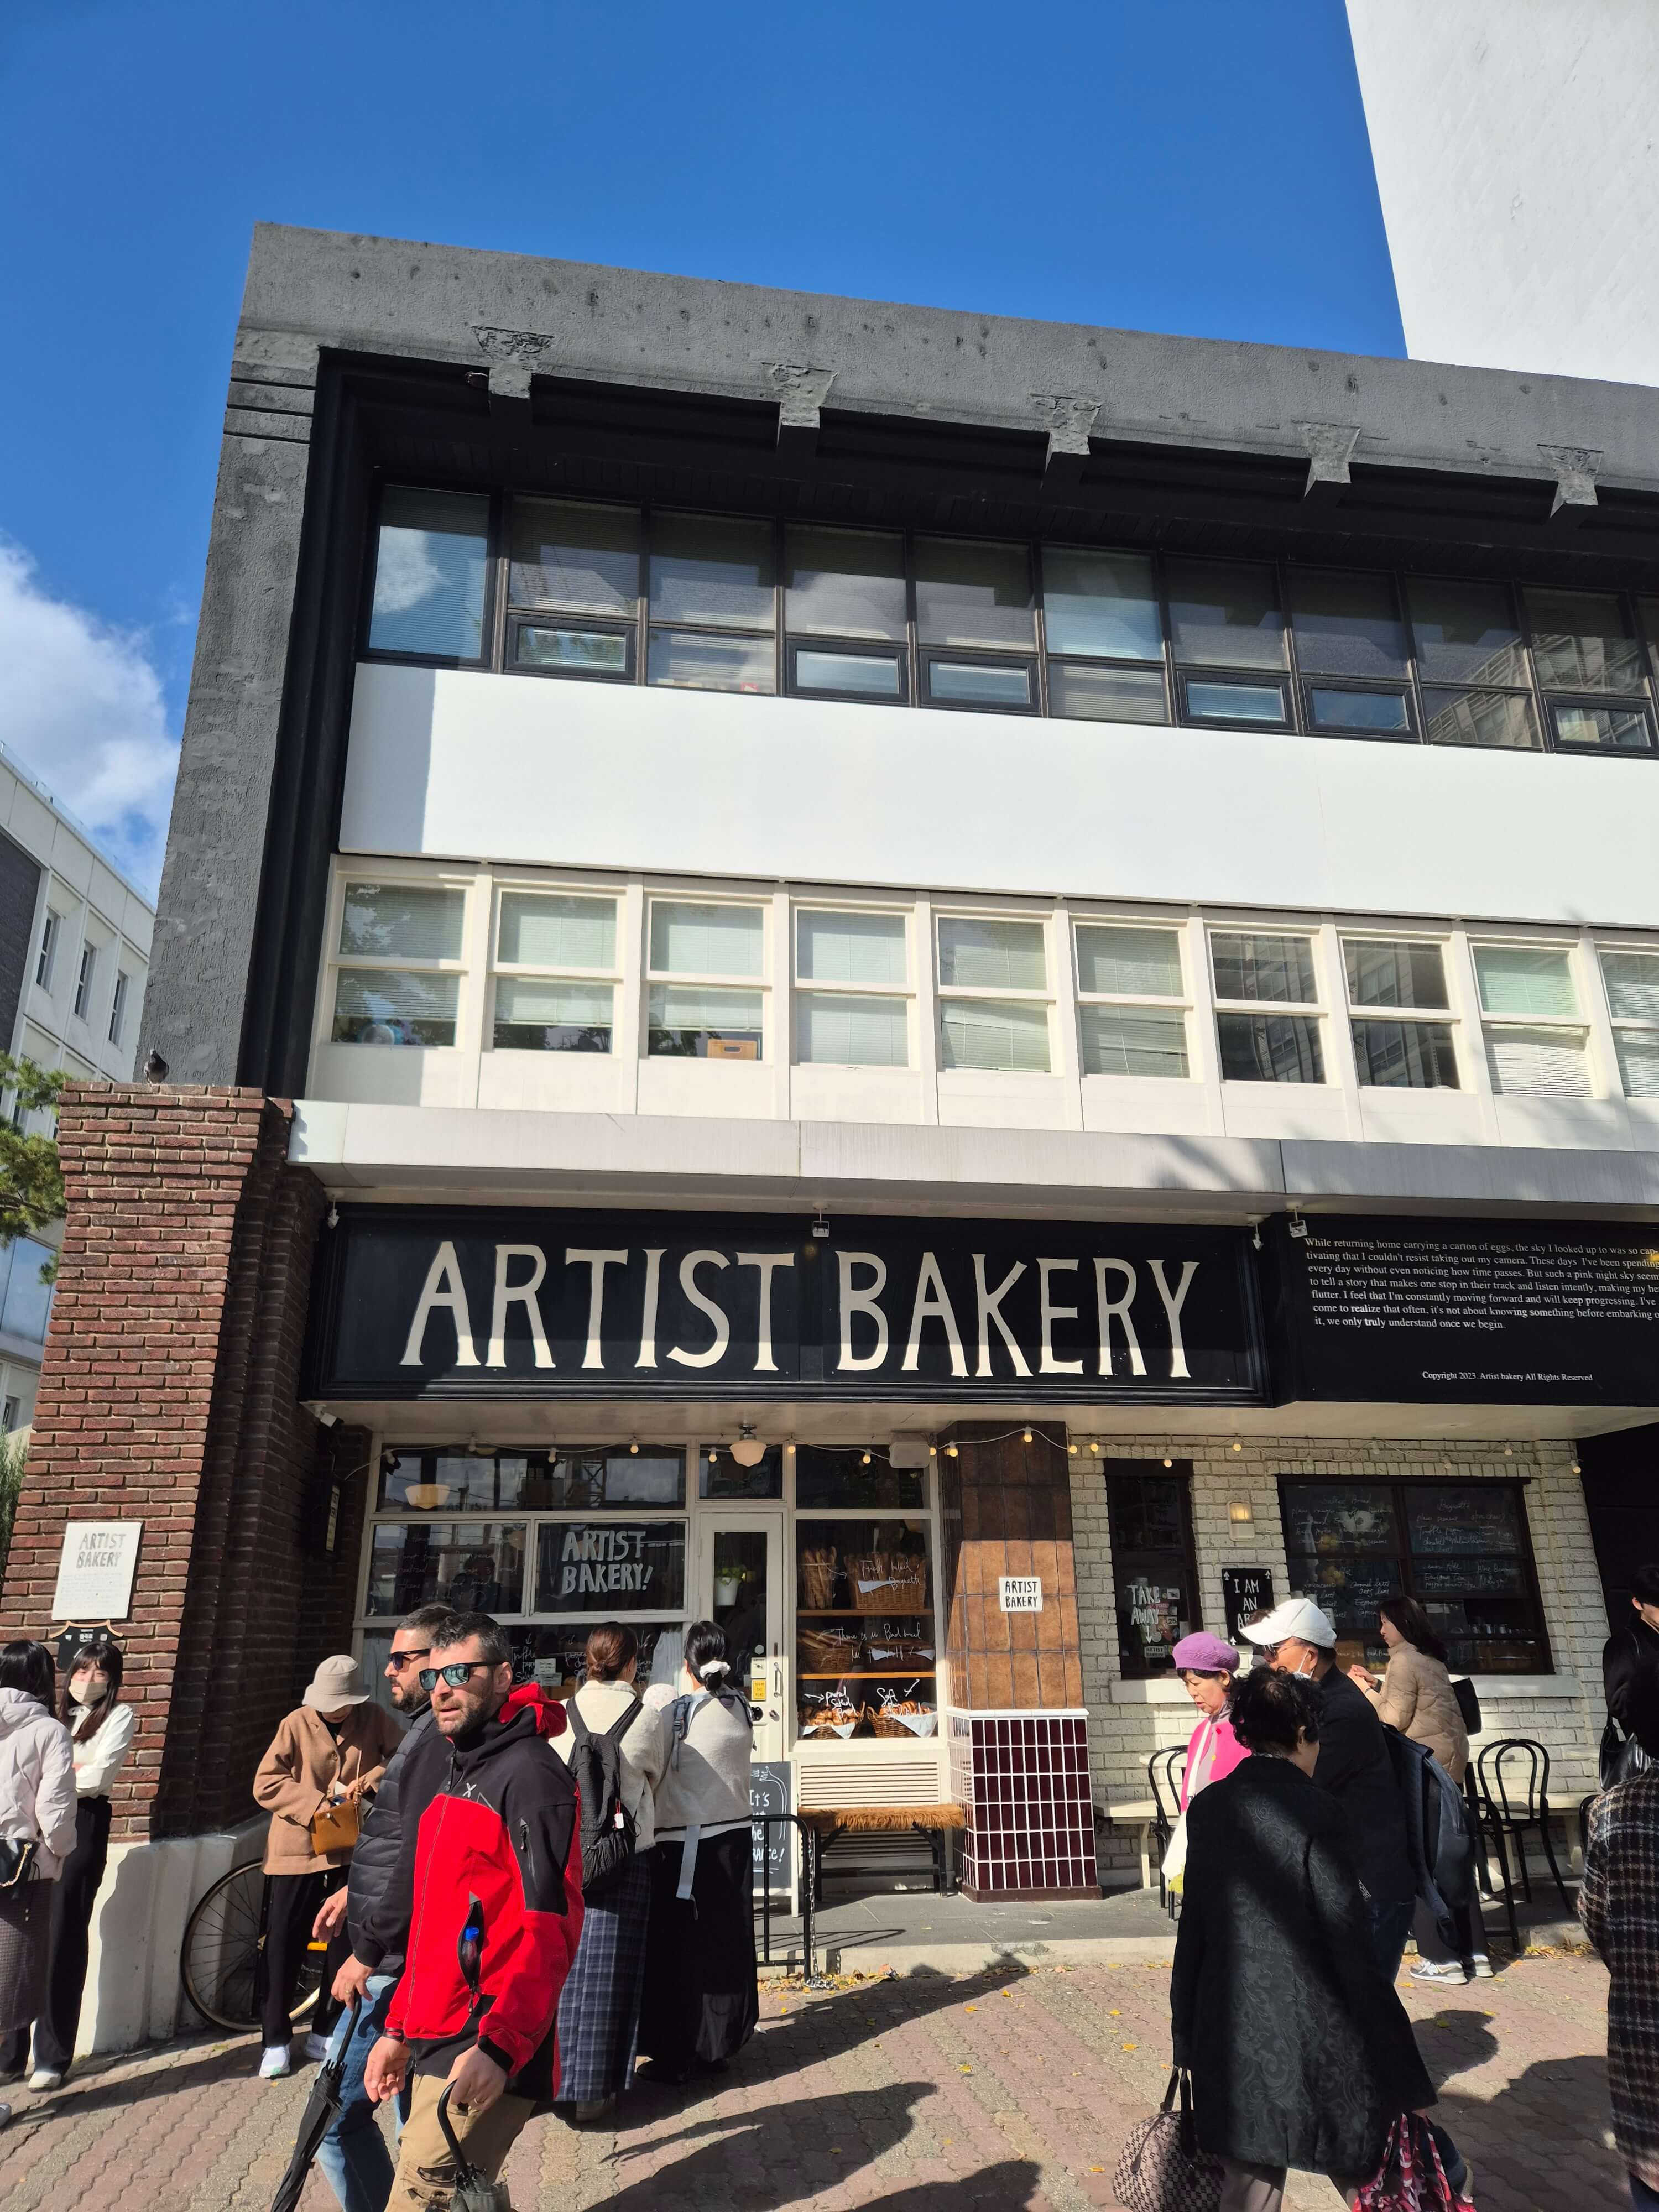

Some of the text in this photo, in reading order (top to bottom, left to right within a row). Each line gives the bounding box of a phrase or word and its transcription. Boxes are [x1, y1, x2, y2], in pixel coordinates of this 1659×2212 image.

[1305, 1238, 1332, 1246] While
[1334, 1239, 1375, 1250] returning
[1376, 1240, 1401, 1248] home
[1403, 1241, 1440, 1251] carrying
[1531, 1244, 1546, 1254] sky
[1553, 1244, 1583, 1253] looked
[1585, 1247, 1597, 1255] up
[1306, 1251, 1340, 1262] tivating
[1361, 1252, 1365, 1260] I
[1368, 1253, 1404, 1261] couldn't
[1431, 1254, 1459, 1264] taking
[1478, 1257, 1491, 1265] my
[1529, 1256, 1554, 1265] These
[1557, 1257, 1577, 1267] days
[1582, 1258, 1597, 1266] I've
[1599, 1258, 1620, 1266] been
[1623, 1259, 1659, 1269] spending
[1308, 1266, 1332, 1274] every
[1335, 1265, 1350, 1275] day
[1354, 1265, 1386, 1274] without
[1413, 1266, 1448, 1277] noticing
[1473, 1267, 1491, 1276] time
[1526, 1269, 1542, 1277] But
[1574, 1270, 1593, 1280] pink
[1596, 1270, 1617, 1281] night
[1620, 1271, 1634, 1281] sky
[1321, 1277, 1335, 1285] tell
[1345, 1279, 1367, 1288] story
[1389, 1279, 1418, 1287] makes
[1439, 1281, 1457, 1290] stop
[1459, 1280, 1468, 1288] in
[1470, 1280, 1491, 1289] their
[1493, 1281, 1515, 1290] track
[1535, 1282, 1559, 1290] listen
[1598, 1284, 1630, 1294] making
[1632, 1286, 1645, 1295] my
[1343, 1291, 1347, 1299] I
[1350, 1291, 1366, 1300] feel
[1369, 1291, 1386, 1300] that
[1389, 1292, 1403, 1300] I'm
[1405, 1293, 1450, 1303] constantly
[1453, 1293, 1486, 1304] moving
[1489, 1294, 1523, 1303] forward
[1525, 1295, 1541, 1303] and
[1562, 1295, 1583, 1306] keep
[399, 1241, 1200, 1378] ARTIST BAKERY
[1351, 1305, 1380, 1313] realize
[1383, 1305, 1400, 1313] that
[1431, 1305, 1443, 1314] it's
[1490, 1307, 1527, 1318] knowing
[1530, 1308, 1574, 1319] something
[1577, 1308, 1604, 1317] before
[1606, 1310, 1652, 1321] embarking
[1342, 1317, 1362, 1328] only
[1364, 1317, 1386, 1328] truly
[1388, 1318, 1437, 1327] understand
[1478, 1319, 1506, 1331] begin.
[1422, 1371, 1458, 1381] Copyright
[1500, 1373, 1524, 1382] bakery
[1537, 1373, 1560, 1383] Rights
[79, 1533, 127, 1550] ARTIST
[561, 1530, 646, 1562] ARTIST
[76, 1551, 122, 1569] BAKERY
[561, 1563, 653, 1594] BAKERY!
[1005, 1580, 1038, 1593] ARTIST
[1234, 1579, 1259, 1594] I AM
[1005, 1595, 1038, 1608] BAKERY
[1126, 1584, 1161, 1605] TAKE
[1243, 1596, 1258, 1611] AN
[1131, 1606, 1159, 1626] AWAY
